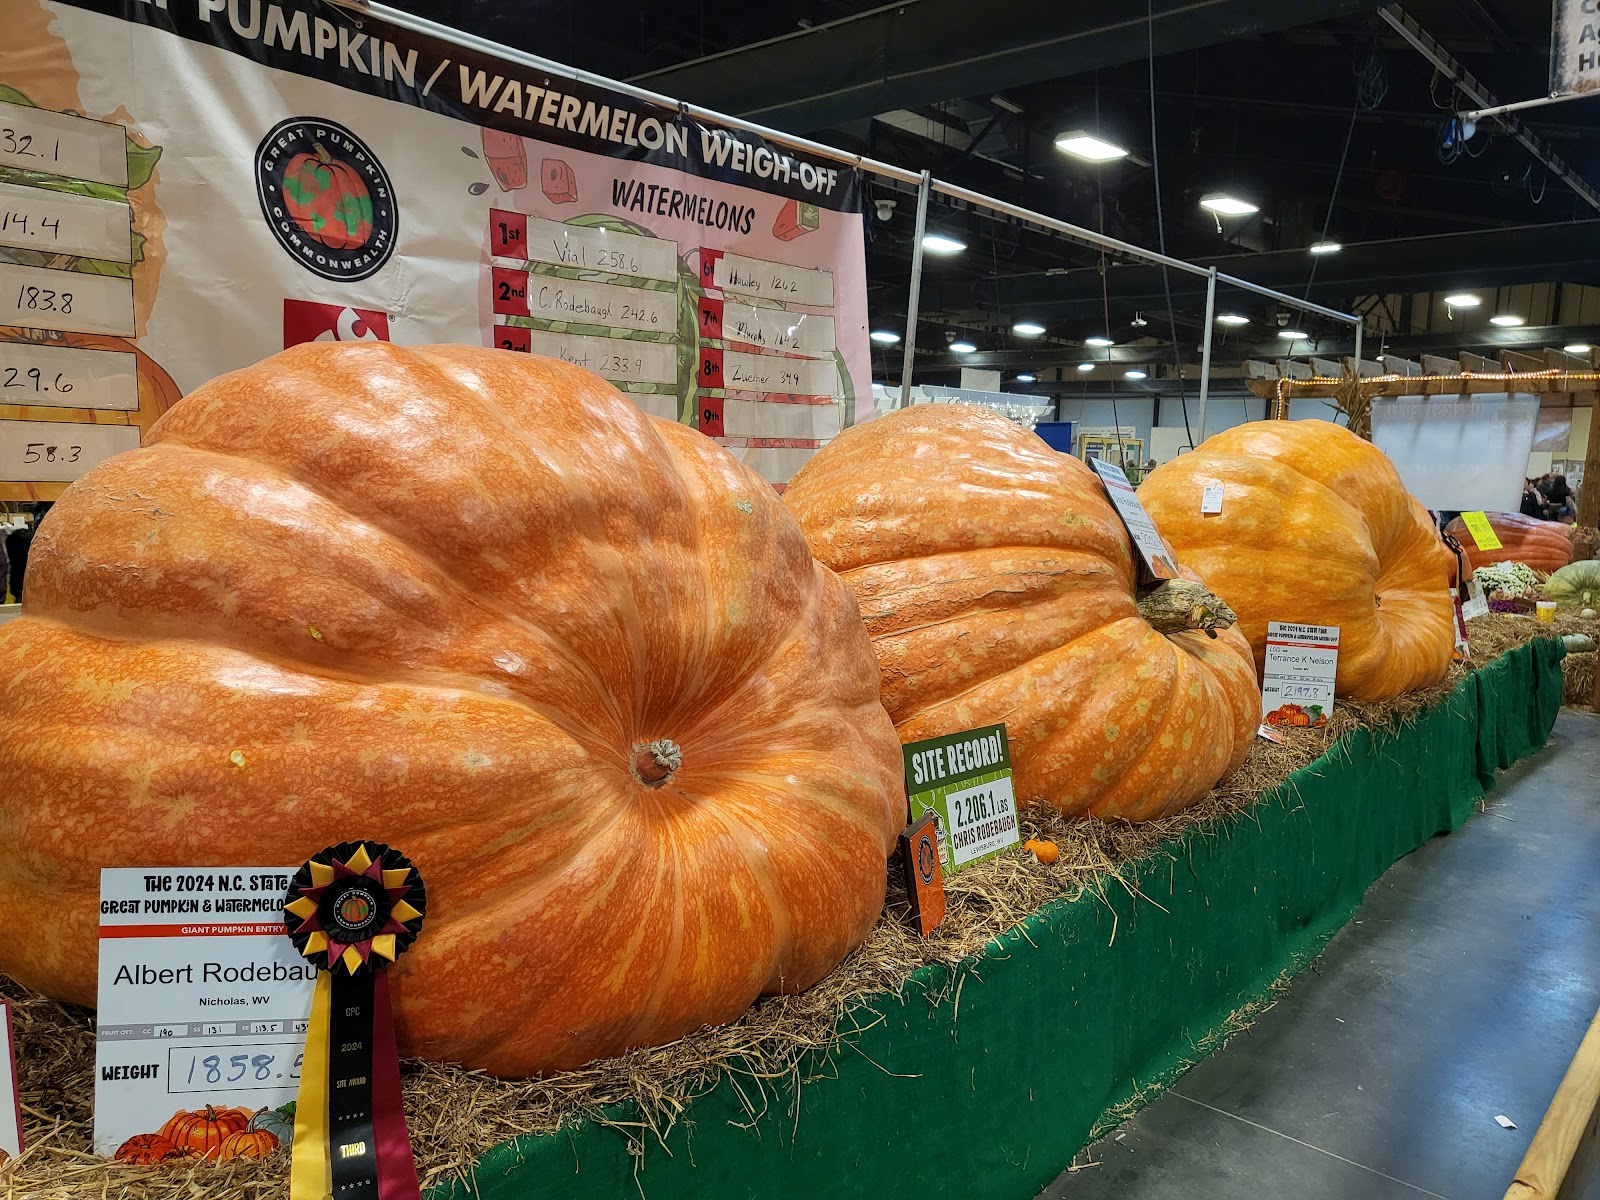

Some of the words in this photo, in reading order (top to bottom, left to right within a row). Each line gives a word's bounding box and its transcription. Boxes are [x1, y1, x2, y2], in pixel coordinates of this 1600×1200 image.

[199, 0, 419, 88] PUMPKIN
[458, 64, 689, 158] WATERMELON
[700, 131, 838, 197] WEIGH-OFF
[264, 128, 305, 172] GREAT
[316, 128, 387, 199] PUMPKIN
[612, 178, 756, 236] WATERMELONS
[273, 206, 387, 270] COMMONWEALTH
[498, 222, 520, 245] 1st
[597, 249, 639, 273] 258.6
[17, 284, 74, 314] 183.8
[498, 281, 525, 302] 2nd
[620, 305, 658, 324] 242.6
[702, 309, 718, 326] 7th
[600, 354, 642, 375] 233.9
[703, 359, 720, 376] 8th
[3, 367, 74, 393] 29.6
[703, 408, 720, 425] 9th
[23, 443, 82, 464] 58.3
[1269, 653, 1300, 663] Terrance
[1309, 656, 1334, 665] Nelson
[911, 747, 946, 785] SITE
[946, 729, 1004, 776] RECORD!
[954, 790, 996, 829] 2,206.1
[953, 827, 976, 850] CHRIS
[977, 814, 1016, 842] RODEBAUGH
[176, 874, 214, 892] 2024
[218, 874, 246, 892] N.C.
[202, 899, 212, 913] &
[181, 926, 210, 935] GIANT
[211, 926, 254, 934] PUMPKIN
[255, 925, 285, 933] ENTRY
[113, 963, 193, 986] Albert
[203, 961, 318, 983] Rodebau
[199, 997, 249, 1007] Nicholas,
[252, 996, 270, 1004] WV
[345, 1006, 360, 1017] GPC
[341, 1041, 363, 1053] 2024
[101, 1064, 160, 1081] WEIGHT
[336, 1078, 347, 1089] SITE
[340, 1141, 367, 1159] THIRD
